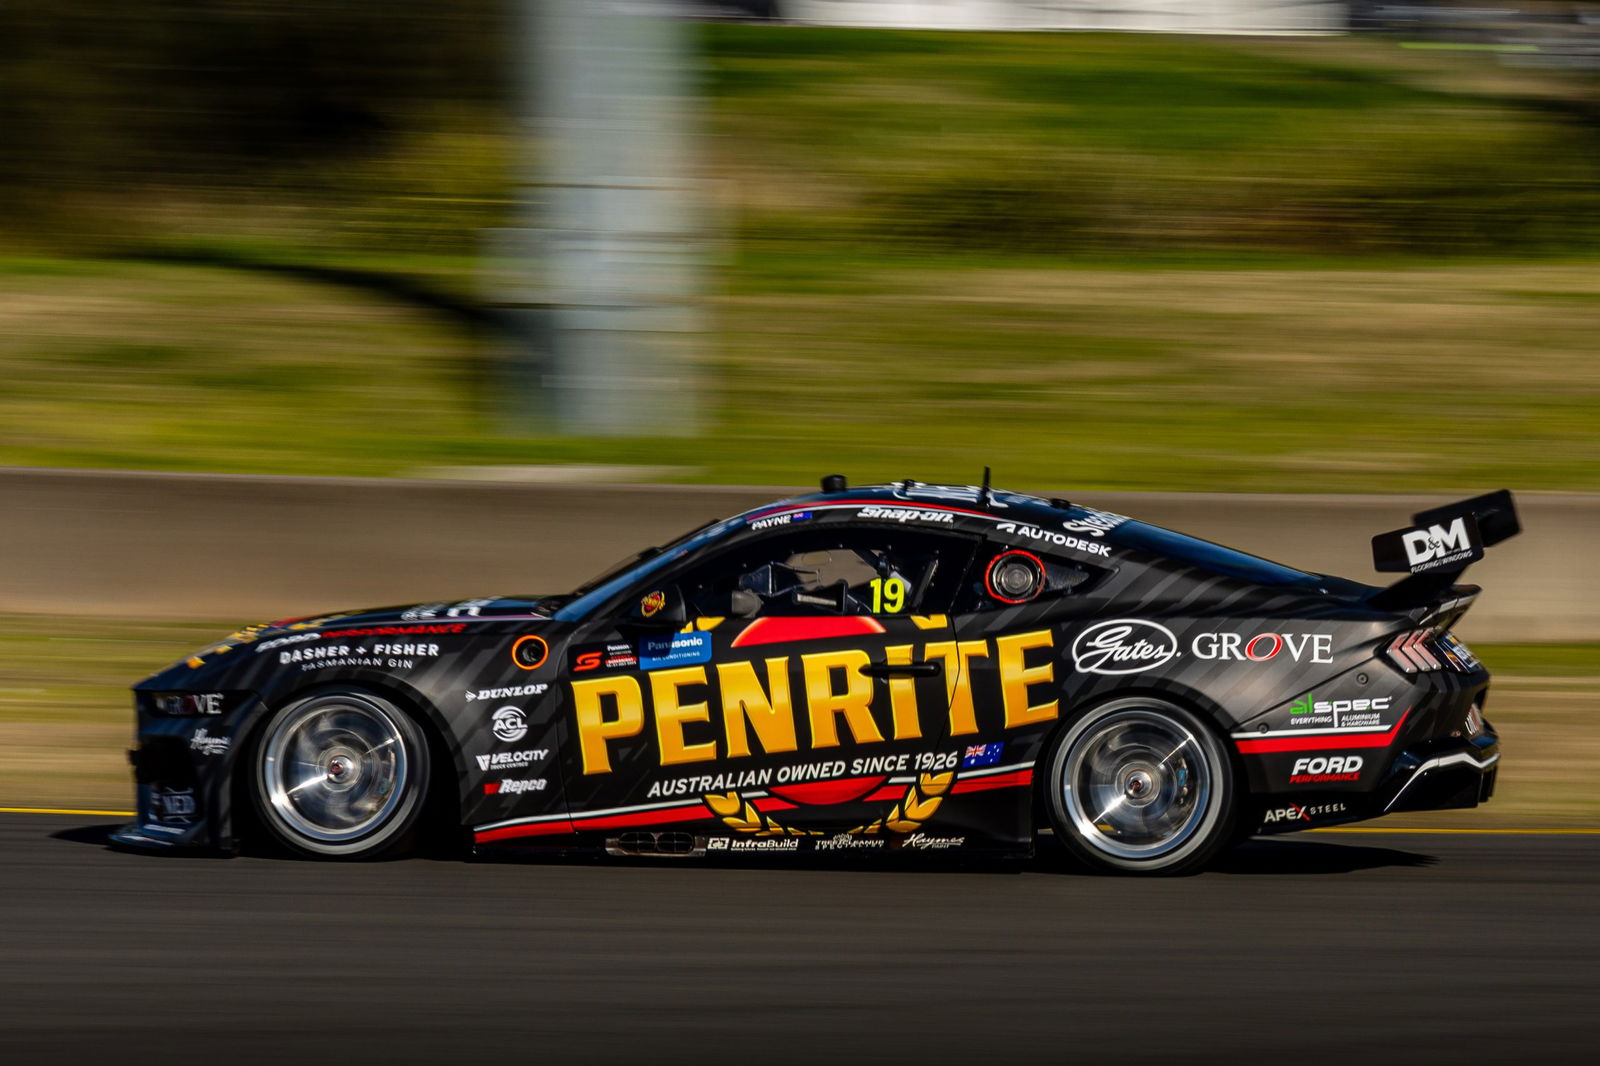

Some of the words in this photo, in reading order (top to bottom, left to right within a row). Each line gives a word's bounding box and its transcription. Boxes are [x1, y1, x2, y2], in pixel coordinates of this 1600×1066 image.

[751, 515, 792, 531] PAYNE
[1016, 526, 1113, 558] AUTODESK
[1401, 517, 1472, 567] D&M
[870, 577, 905, 614] 19
[279, 645, 351, 665] DASNER
[373, 643, 440, 657] FISHER
[648, 636, 704, 651] Panasonic
[1076, 625, 1170, 673] Gates
[1191, 631, 1334, 664] GROVE
[301, 656, 383, 672] TASMANIAN
[387, 657, 414, 669] GIN
[477, 683, 549, 700] DUNLOP
[570, 628, 1060, 776] PENRITE
[1289, 693, 1391, 728] alspec
[1290, 715, 1333, 726] EVERYTHING
[492, 718, 529, 732] ACL
[491, 749, 550, 764] VELOCITY
[1291, 755, 1364, 776] FORD
[647, 769, 772, 799] AUSTRALIAN
[776, 760, 847, 783] OWNED
[850, 753, 910, 776] SINCE
[913, 750, 959, 772] 1926
[1289, 772, 1361, 784] PERFORMANCE
[498, 779, 548, 795] Repco
[1263, 802, 1312, 824] APEX
[1310, 803, 1347, 815] STEEL
[731, 838, 799, 849] InfraBuild
